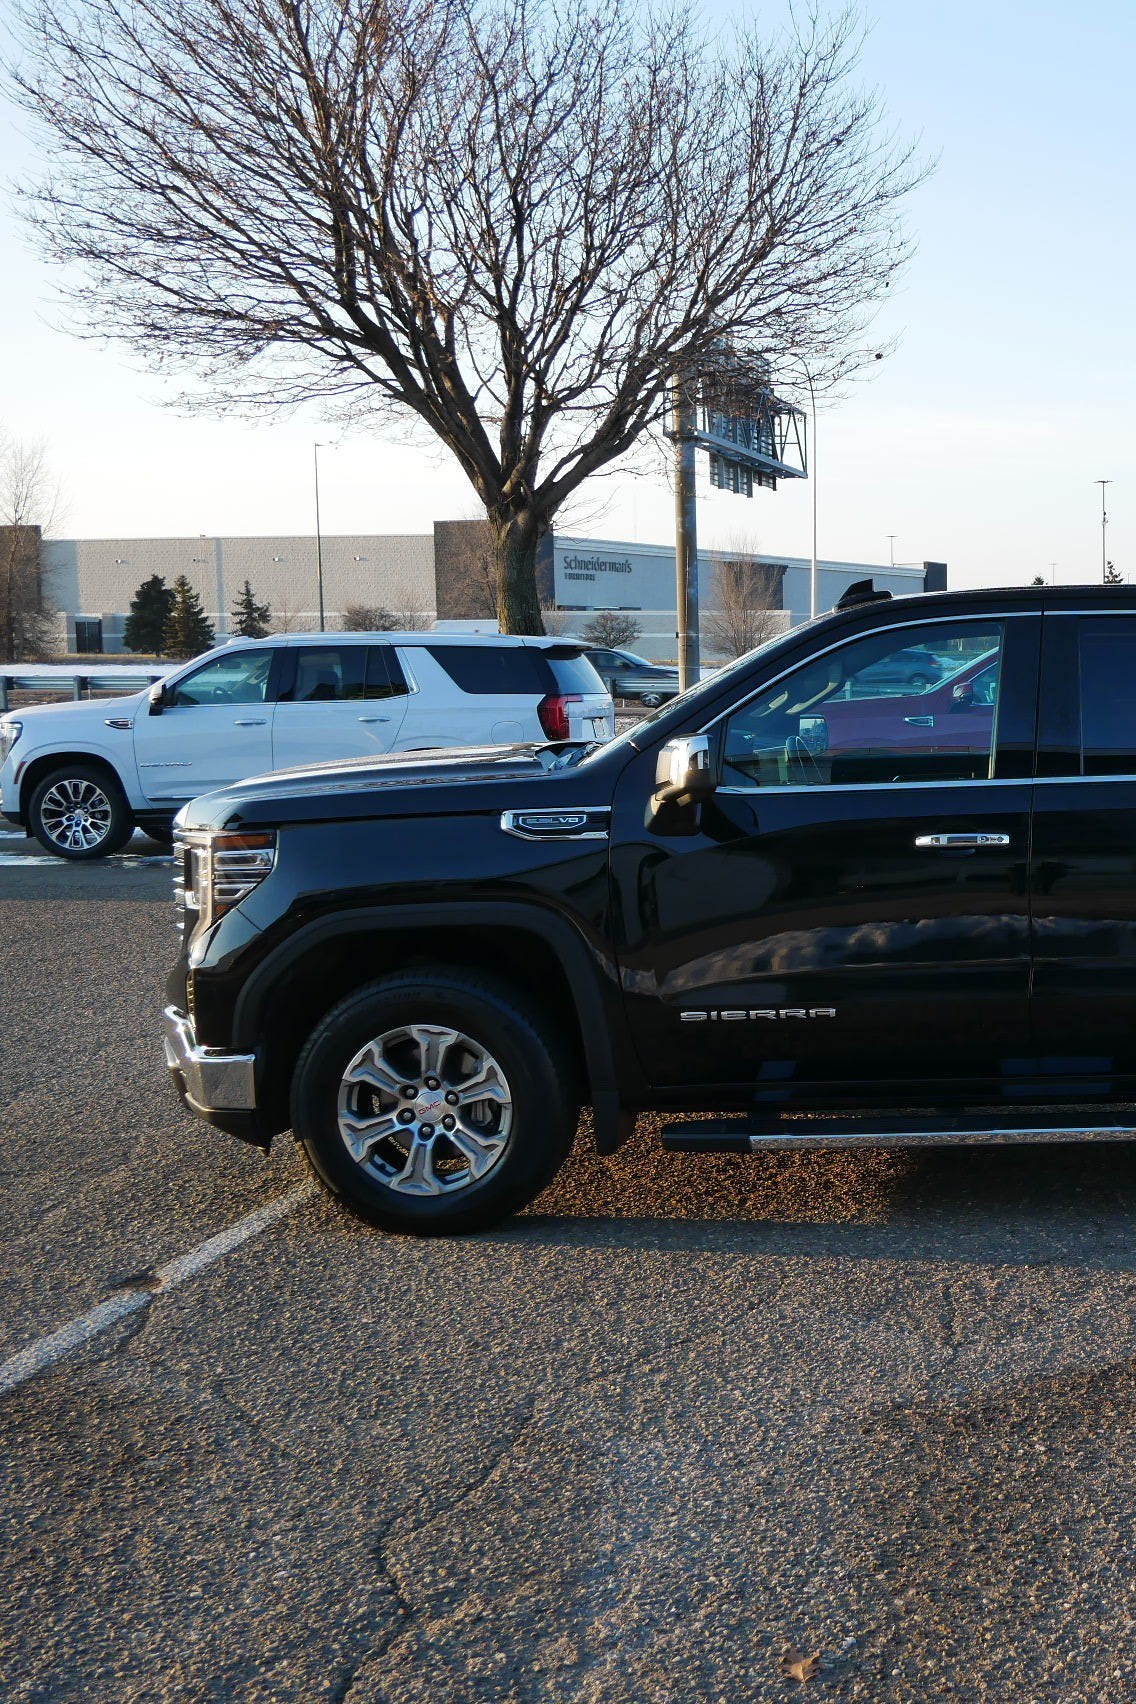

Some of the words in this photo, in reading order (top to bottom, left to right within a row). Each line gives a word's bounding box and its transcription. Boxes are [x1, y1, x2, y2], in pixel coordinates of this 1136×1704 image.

[563, 555, 632, 573] Schneiderman's
[680, 1007, 837, 1021] SIERRA
[418, 1099, 441, 1115] GMC
